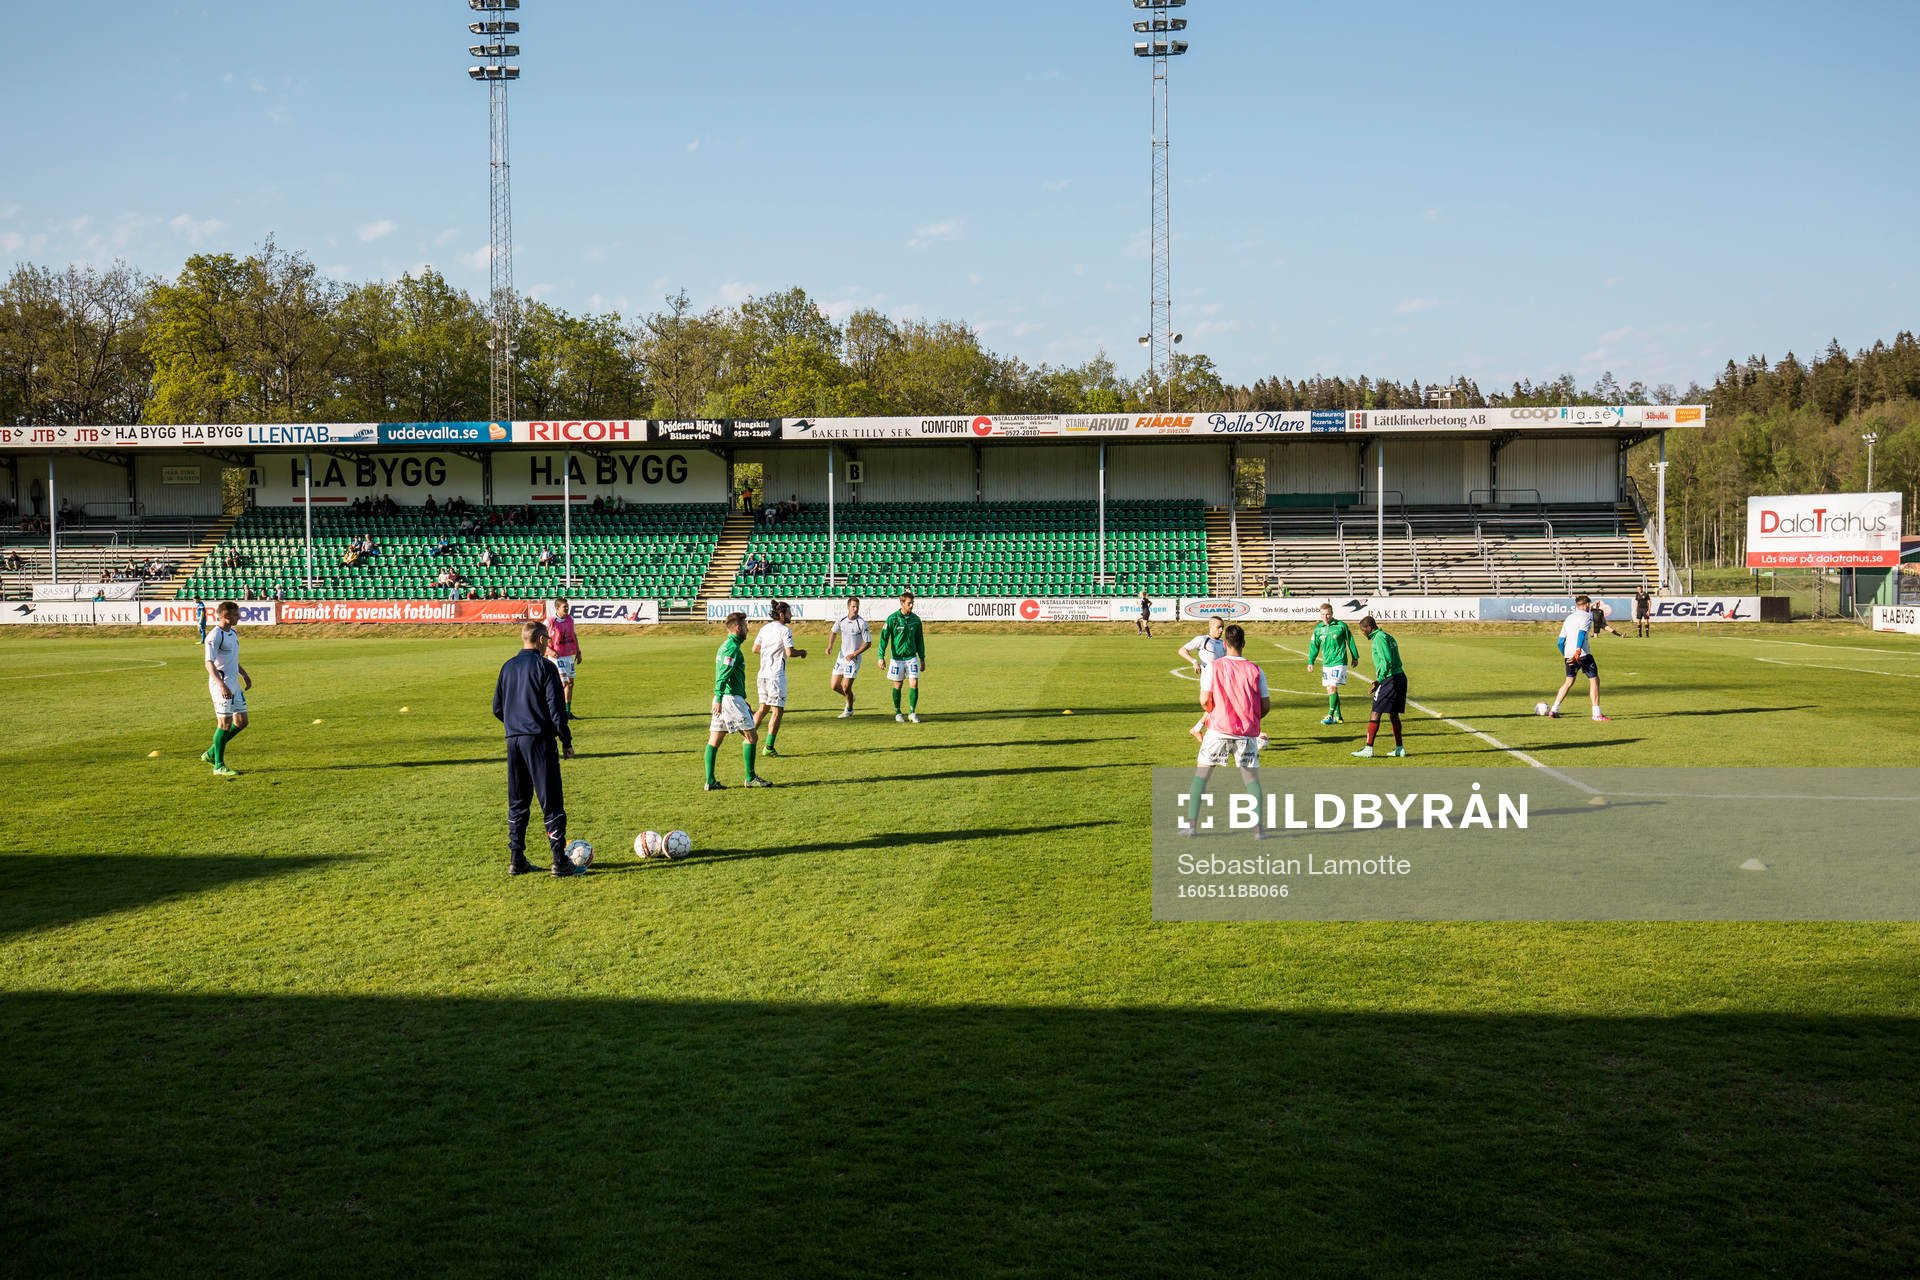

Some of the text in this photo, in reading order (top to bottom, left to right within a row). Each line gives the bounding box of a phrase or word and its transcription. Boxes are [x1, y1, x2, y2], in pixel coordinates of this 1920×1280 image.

[1135, 414, 1195, 428] FJÄRÅS
[1374, 415, 1486, 428] Lättklinkerbetong AB
[1510, 408, 1558, 421] coop
[658, 420, 722, 437] Bröderna Björks
[734, 421, 769, 429] Ljungskile
[921, 420, 969, 434] COMFORT
[1065, 418, 1129, 431] STARKE ARVID
[1208, 413, 1305, 432] Bella Mare
[30, 429, 55, 442] JTB
[74, 429, 99, 442] JTB
[115, 427, 176, 439] H.A BYGG
[182, 426, 243, 439] H.A BYGG
[388, 425, 479, 440] uddevalla.se
[529, 422, 630, 441] RICOH
[812, 428, 912, 438] BAKER TILLY SEK
[291, 456, 447, 488] H.A BYGG
[530, 454, 688, 486] H.A BYGG
[849, 464, 860, 480] B
[249, 470, 259, 485] A
[1760, 508, 1886, 534] DalaTrähus
[1800, 555, 1814, 564] på
[281, 603, 456, 620] Framåt för svensk fotboll!
[569, 604, 628, 619] EGEA
[967, 603, 1017, 617] COMFORT
[1368, 609, 1476, 619] BAKER TILLY SEK
[1510, 602, 1576, 614] uddevalla.s
[33, 613, 132, 622] BAKER TILY SEK
[1882, 609, 1915, 625] H.A BYGG
